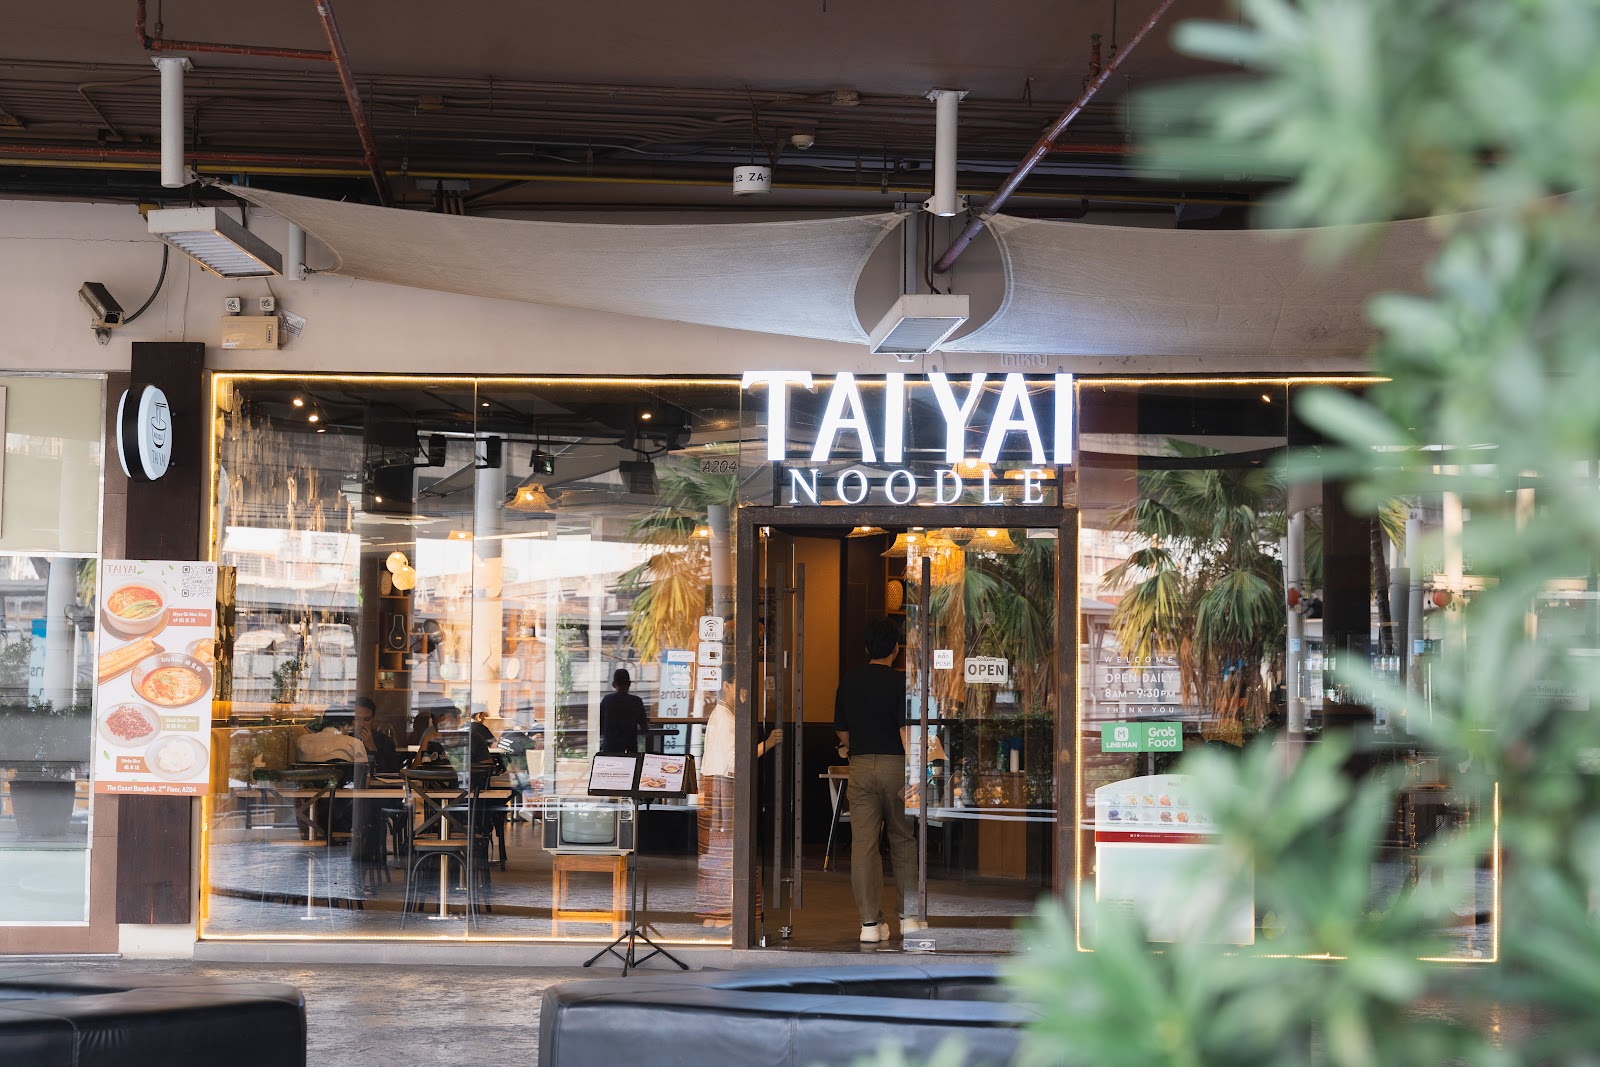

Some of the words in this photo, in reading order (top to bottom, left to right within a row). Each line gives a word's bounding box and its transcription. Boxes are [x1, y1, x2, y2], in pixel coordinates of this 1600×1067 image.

[702, 460, 738, 473] A204
[788, 468, 1044, 506] NOODLE
[968, 664, 1004, 676] OPEN
[1105, 673, 1136, 683] OPEN
[1142, 673, 1174, 683] DAILY
[1148, 726, 1176, 737] Grab
[1148, 737, 1176, 747] Food
